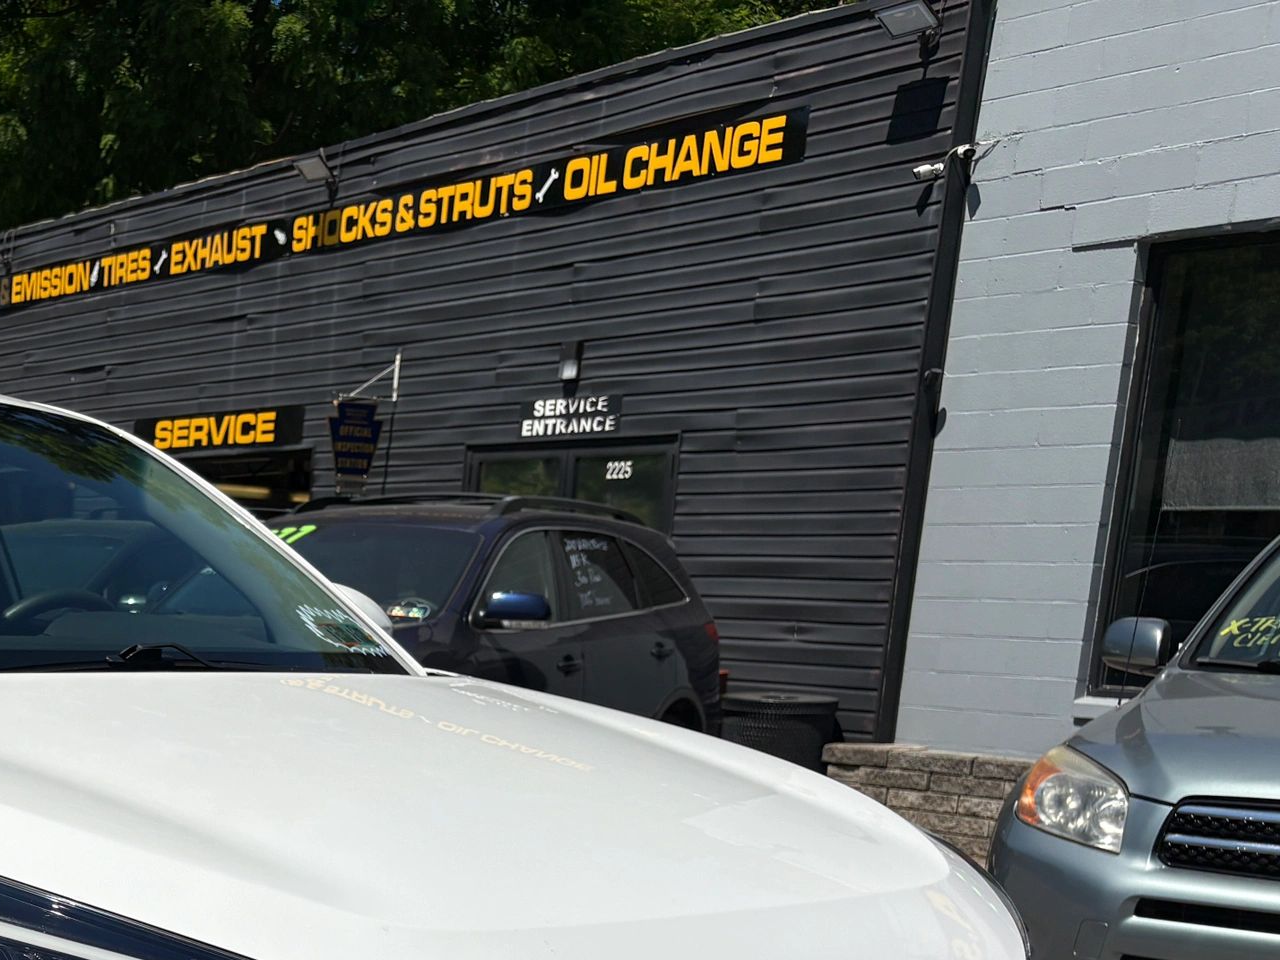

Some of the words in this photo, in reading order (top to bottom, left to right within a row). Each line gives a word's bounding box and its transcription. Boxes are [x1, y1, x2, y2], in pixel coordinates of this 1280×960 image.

[11, 260, 91, 304] EMISSION
[101, 247, 152, 288] TIRES
[169, 224, 268, 275] EXHAUST
[292, 198, 394, 253] SHOCKS
[395, 194, 415, 232] &
[417, 169, 533, 228] STRUTS
[563, 152, 618, 201] OIL
[622, 114, 787, 190] CHANGE
[533, 395, 609, 417] SERVICE
[153, 411, 277, 450] SERVICE
[521, 414, 617, 437] ENTRANCE
[605, 460, 633, 480] 2225
